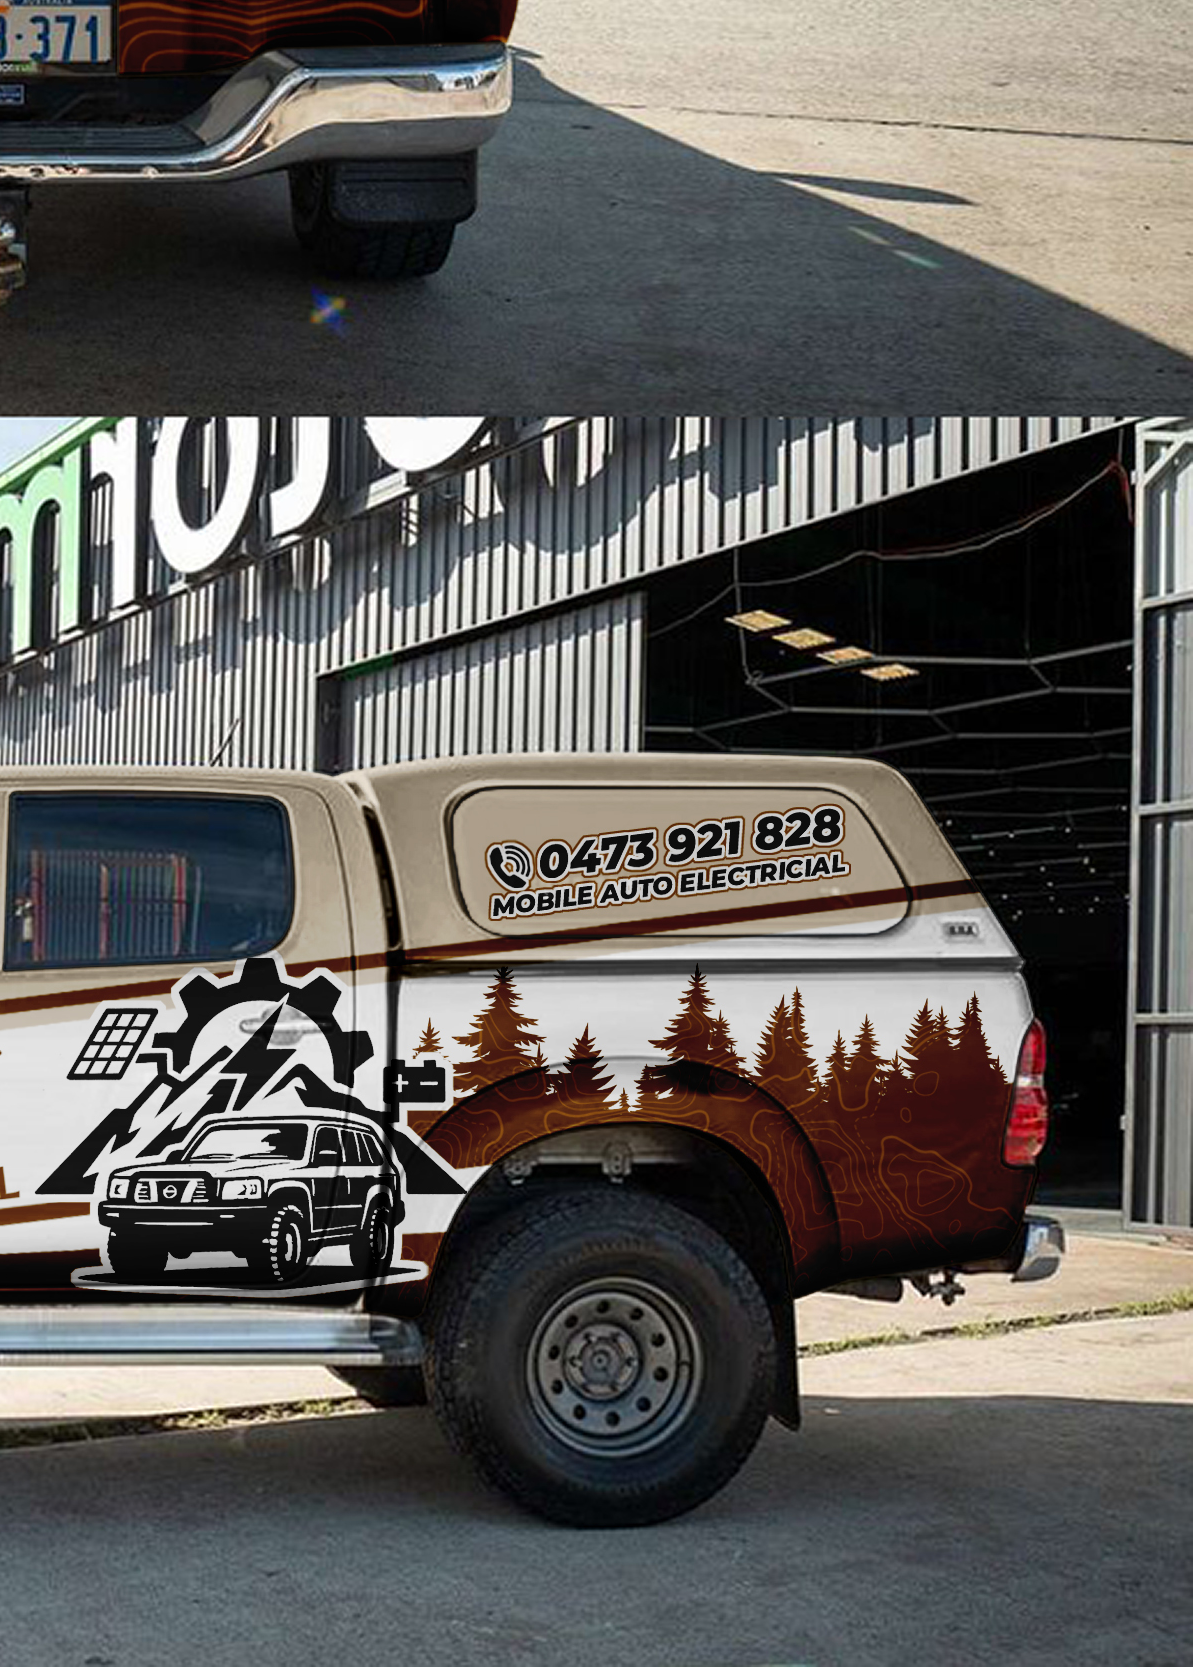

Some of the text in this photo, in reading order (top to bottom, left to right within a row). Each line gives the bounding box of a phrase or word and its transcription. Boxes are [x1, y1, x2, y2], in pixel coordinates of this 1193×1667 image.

[539, 808, 842, 879] 0473 921 828
[492, 853, 847, 917] MOBILE AUTO ELECTRICIAL
